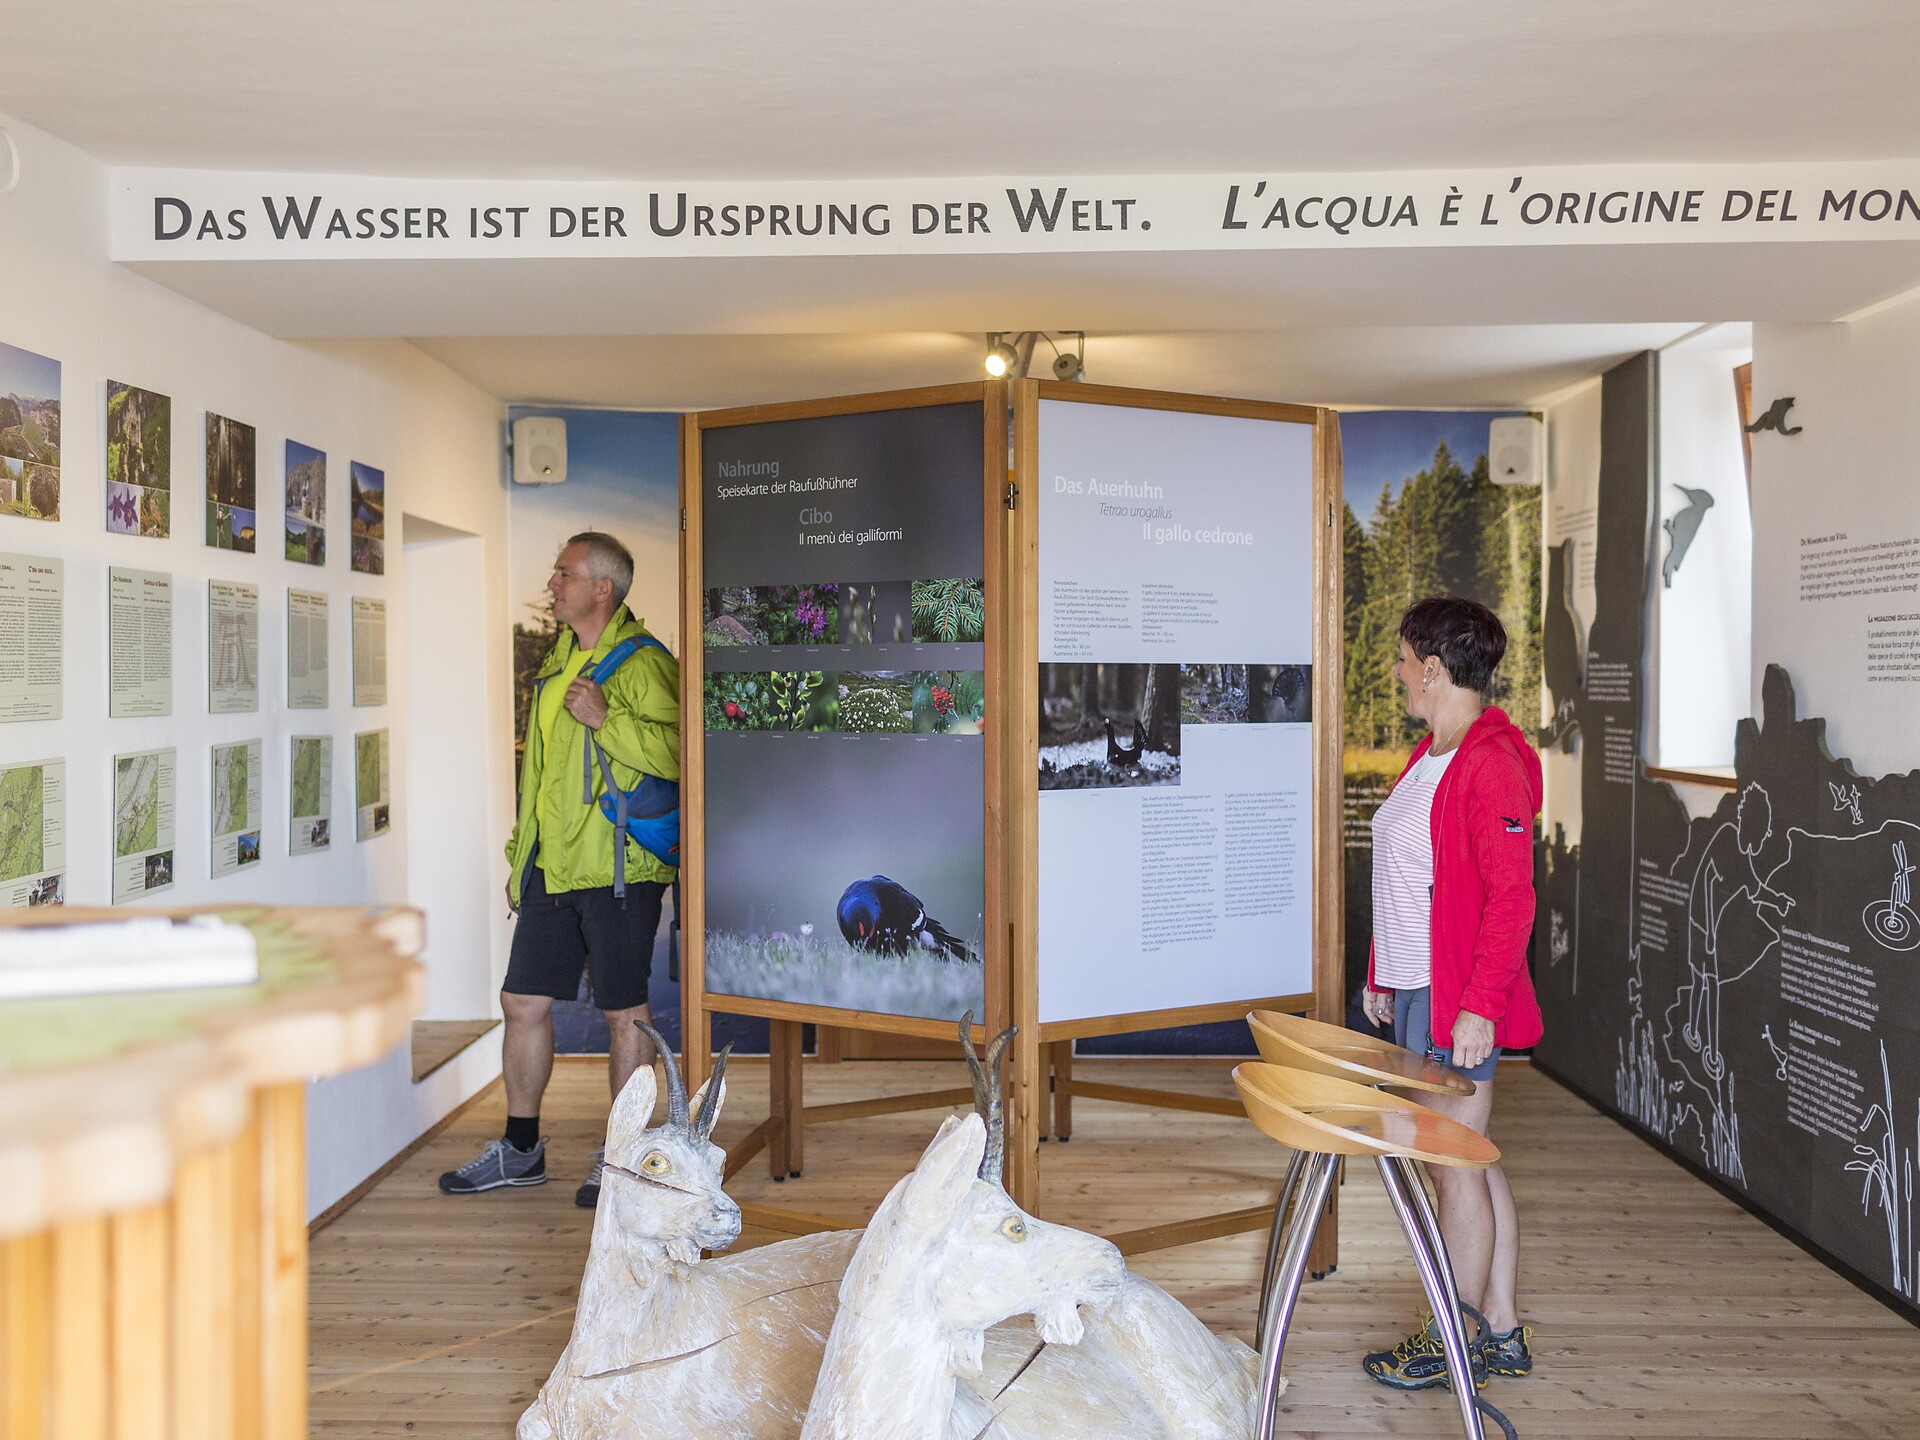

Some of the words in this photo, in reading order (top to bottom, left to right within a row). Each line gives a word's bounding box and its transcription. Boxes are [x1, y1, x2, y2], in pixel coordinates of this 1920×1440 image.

[154, 197, 247, 241] DAS
[261, 196, 450, 240] WASSER
[470, 207, 530, 239] IST
[549, 206, 628, 238] DER
[649, 192, 890, 237] URSPRUNG
[912, 202, 991, 235] DER
[1005, 187, 1151, 233] WELT.
[1439, 186, 1464, 226] È
[1721, 189, 1798, 222] DEL
[718, 461, 780, 478] Nahrung
[717, 484, 769, 500] Speisekarte
[771, 481, 787, 493] der
[790, 477, 858, 492] Raufußhühner
[1055, 476, 1083, 495] Das
[1088, 478, 1163, 499] Auerhuhn
[799, 507, 833, 524] Cibo
[1100, 502, 1128, 517] Tetrao
[1130, 506, 1173, 521] urogallus
[800, 533, 804, 545] Il
[807, 531, 835, 545] menù
[838, 530, 853, 543] dei
[857, 527, 902, 545] galliformi
[1143, 523, 1151, 540] Il
[1155, 524, 1191, 545] gallo
[1195, 527, 1253, 545] cedrone
